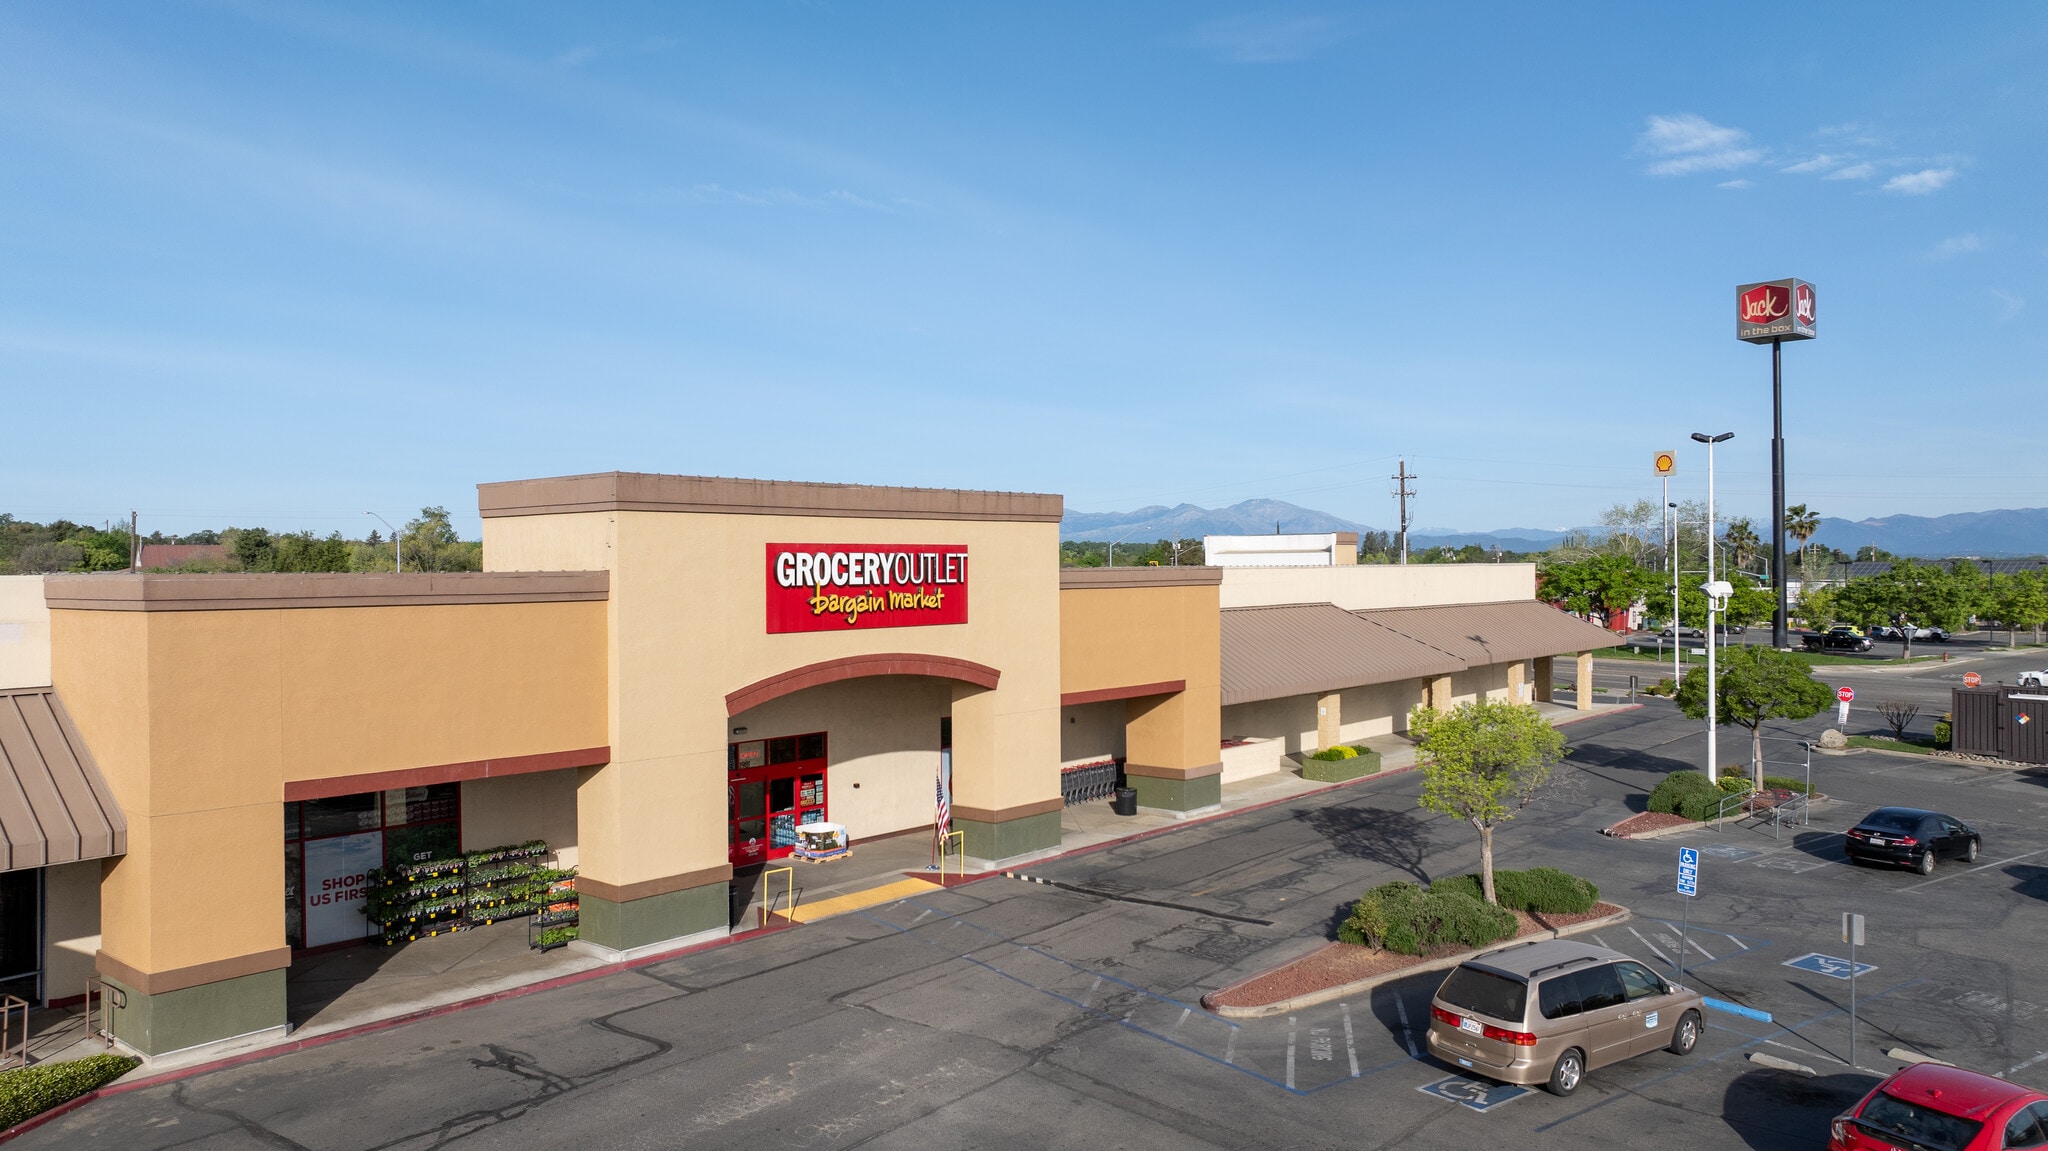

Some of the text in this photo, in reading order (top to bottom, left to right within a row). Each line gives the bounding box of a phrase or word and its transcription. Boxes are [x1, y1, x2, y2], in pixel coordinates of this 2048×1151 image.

[1743, 289, 1788, 320] Jack
[1797, 289, 1815, 321] Jack
[1741, 328, 1750, 337] in
[1752, 327, 1769, 335] the
[810, 580, 884, 624] bargain
[1963, 676, 1980, 684] STOP
[740, 751, 759, 759] OPEN
[413, 851, 432, 861] GET
[322, 874, 365, 891] SHOP
[310, 893, 331, 906] US
